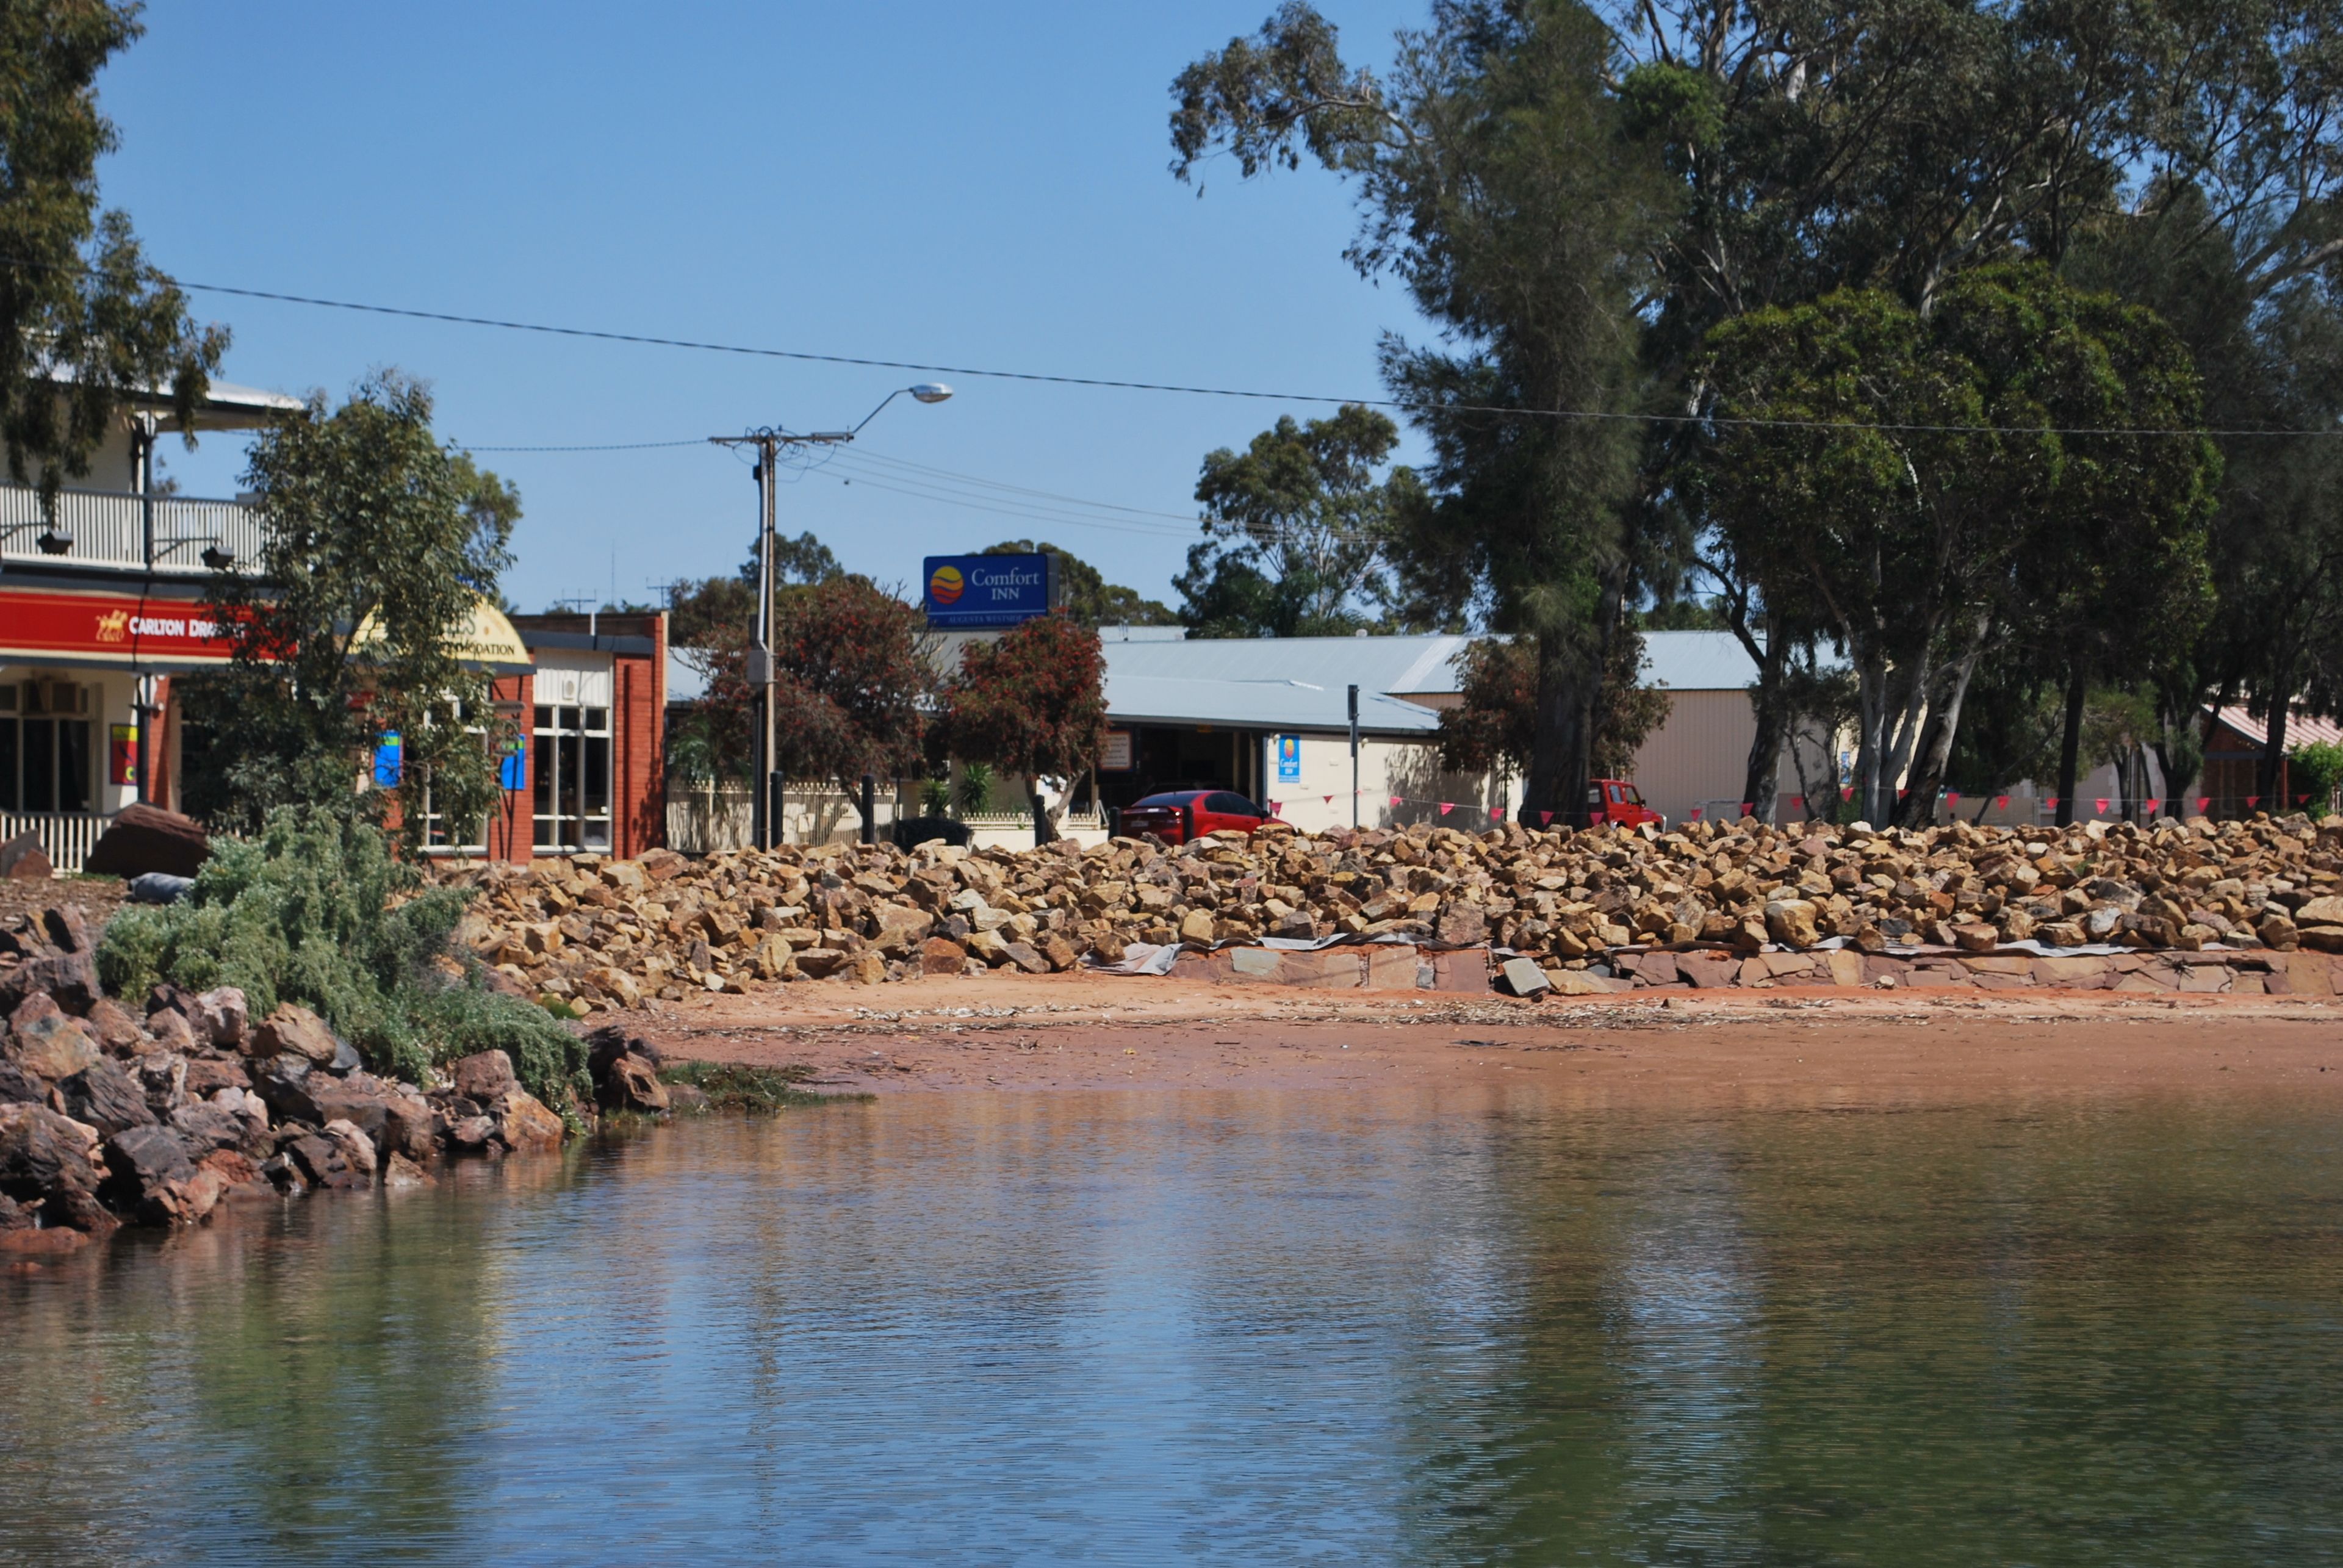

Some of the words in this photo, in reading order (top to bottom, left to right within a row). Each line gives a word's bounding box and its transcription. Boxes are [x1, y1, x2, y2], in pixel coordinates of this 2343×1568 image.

[971, 567, 1039, 586] Comfort
[992, 588, 1020, 600] INN
[129, 616, 185, 636] CARLTON
[949, 615, 984, 624] AUGUSTA
